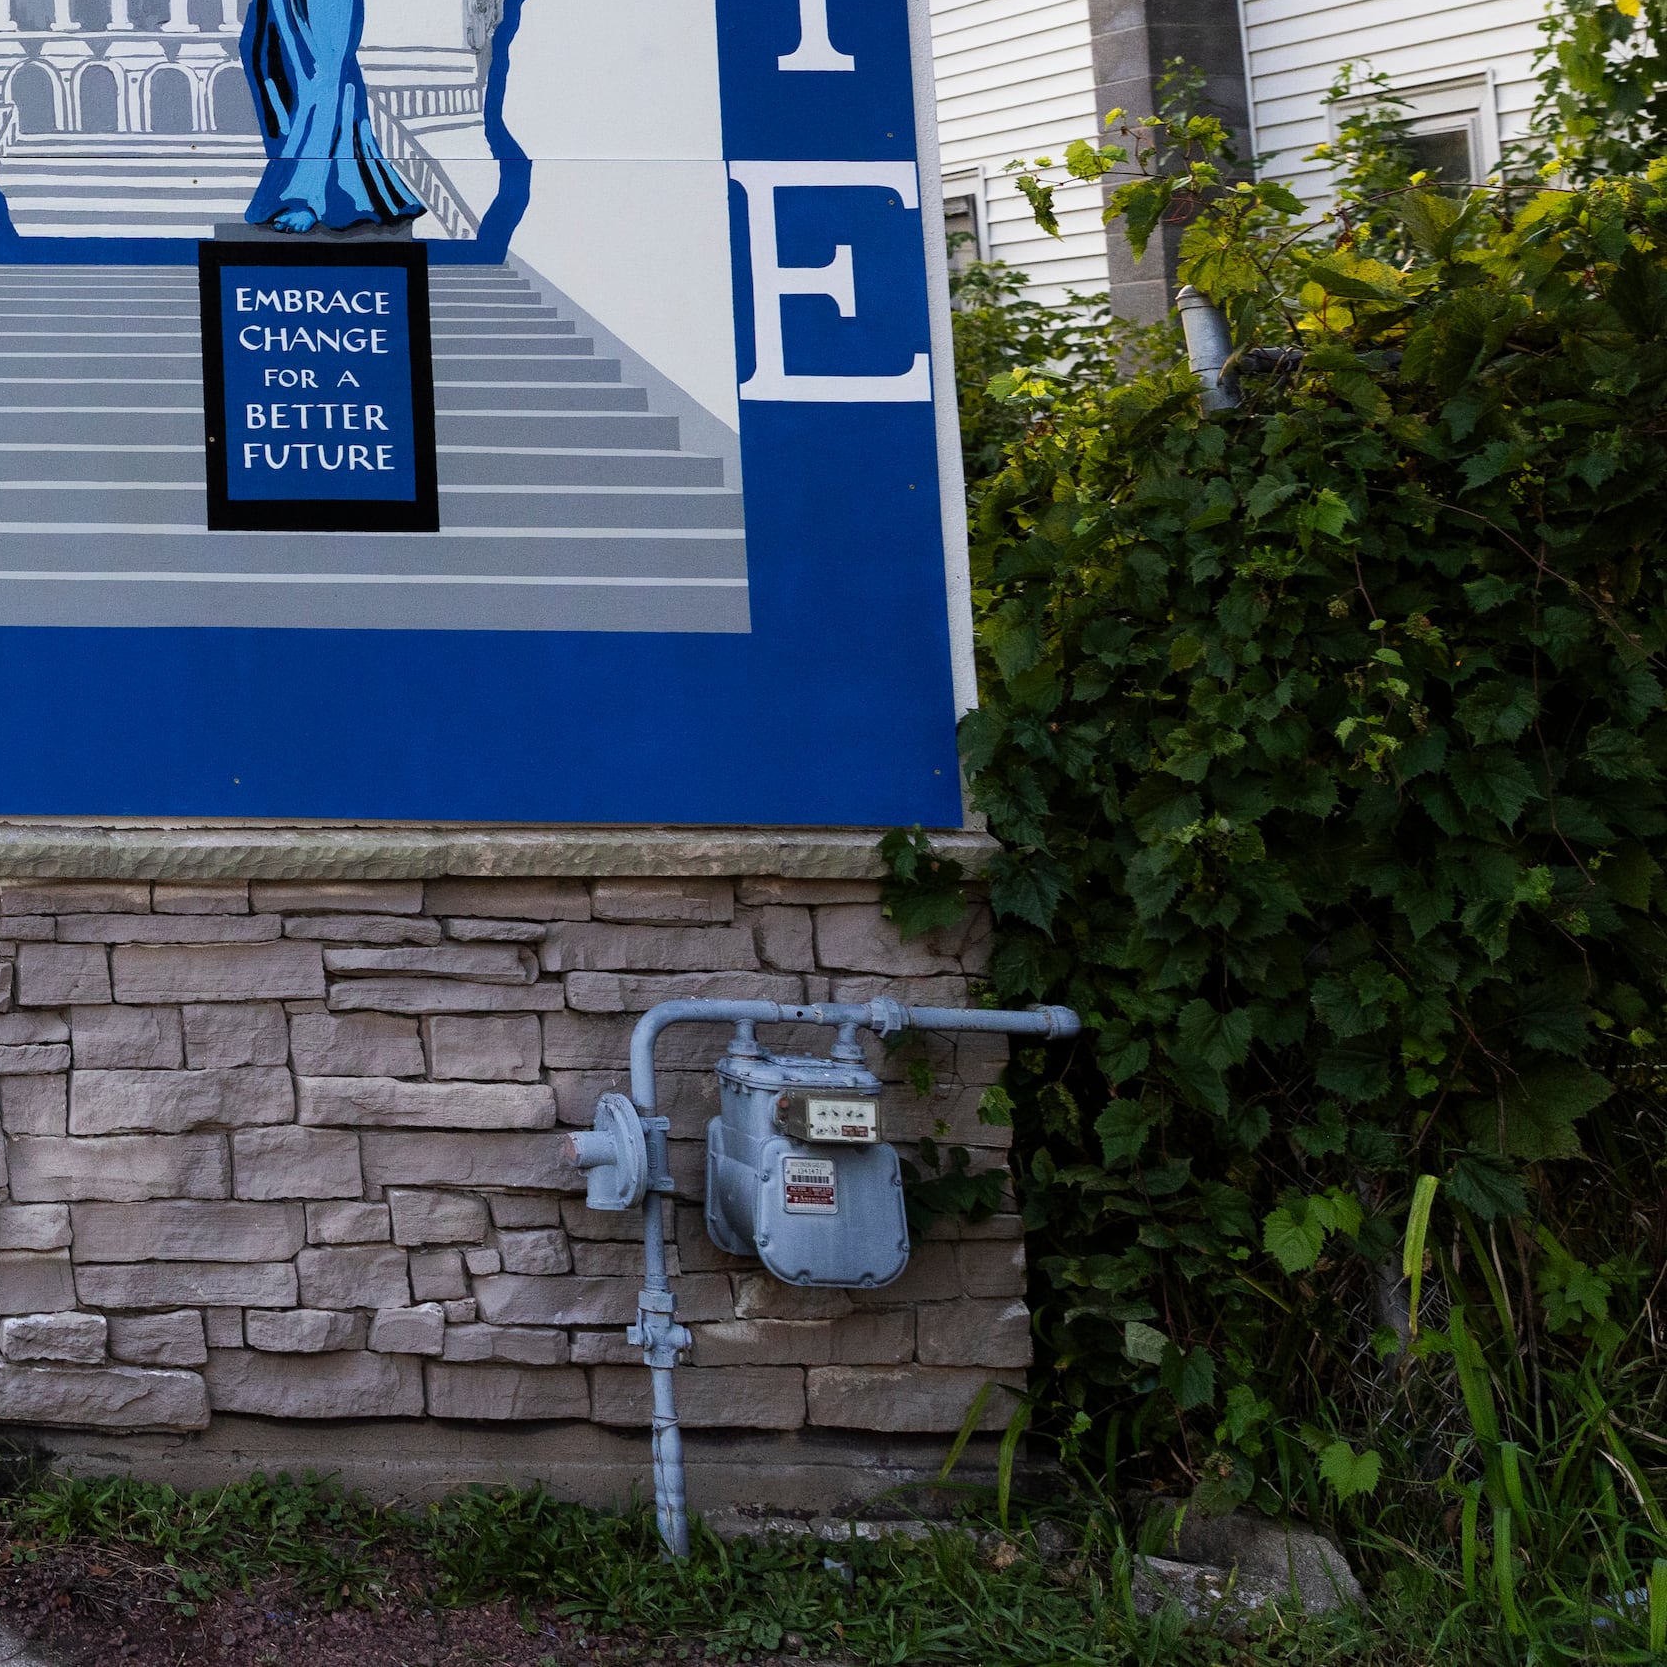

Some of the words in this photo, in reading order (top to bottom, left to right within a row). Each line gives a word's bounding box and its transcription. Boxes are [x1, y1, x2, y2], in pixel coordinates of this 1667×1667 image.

[235, 287, 390, 315] EMBRACE
[239, 325, 389, 354] CHANGE
[264, 368, 319, 389] FOR
[336, 370, 360, 388] A
[245, 403, 389, 431] BETTER
[243, 443, 395, 471] FUTURE
